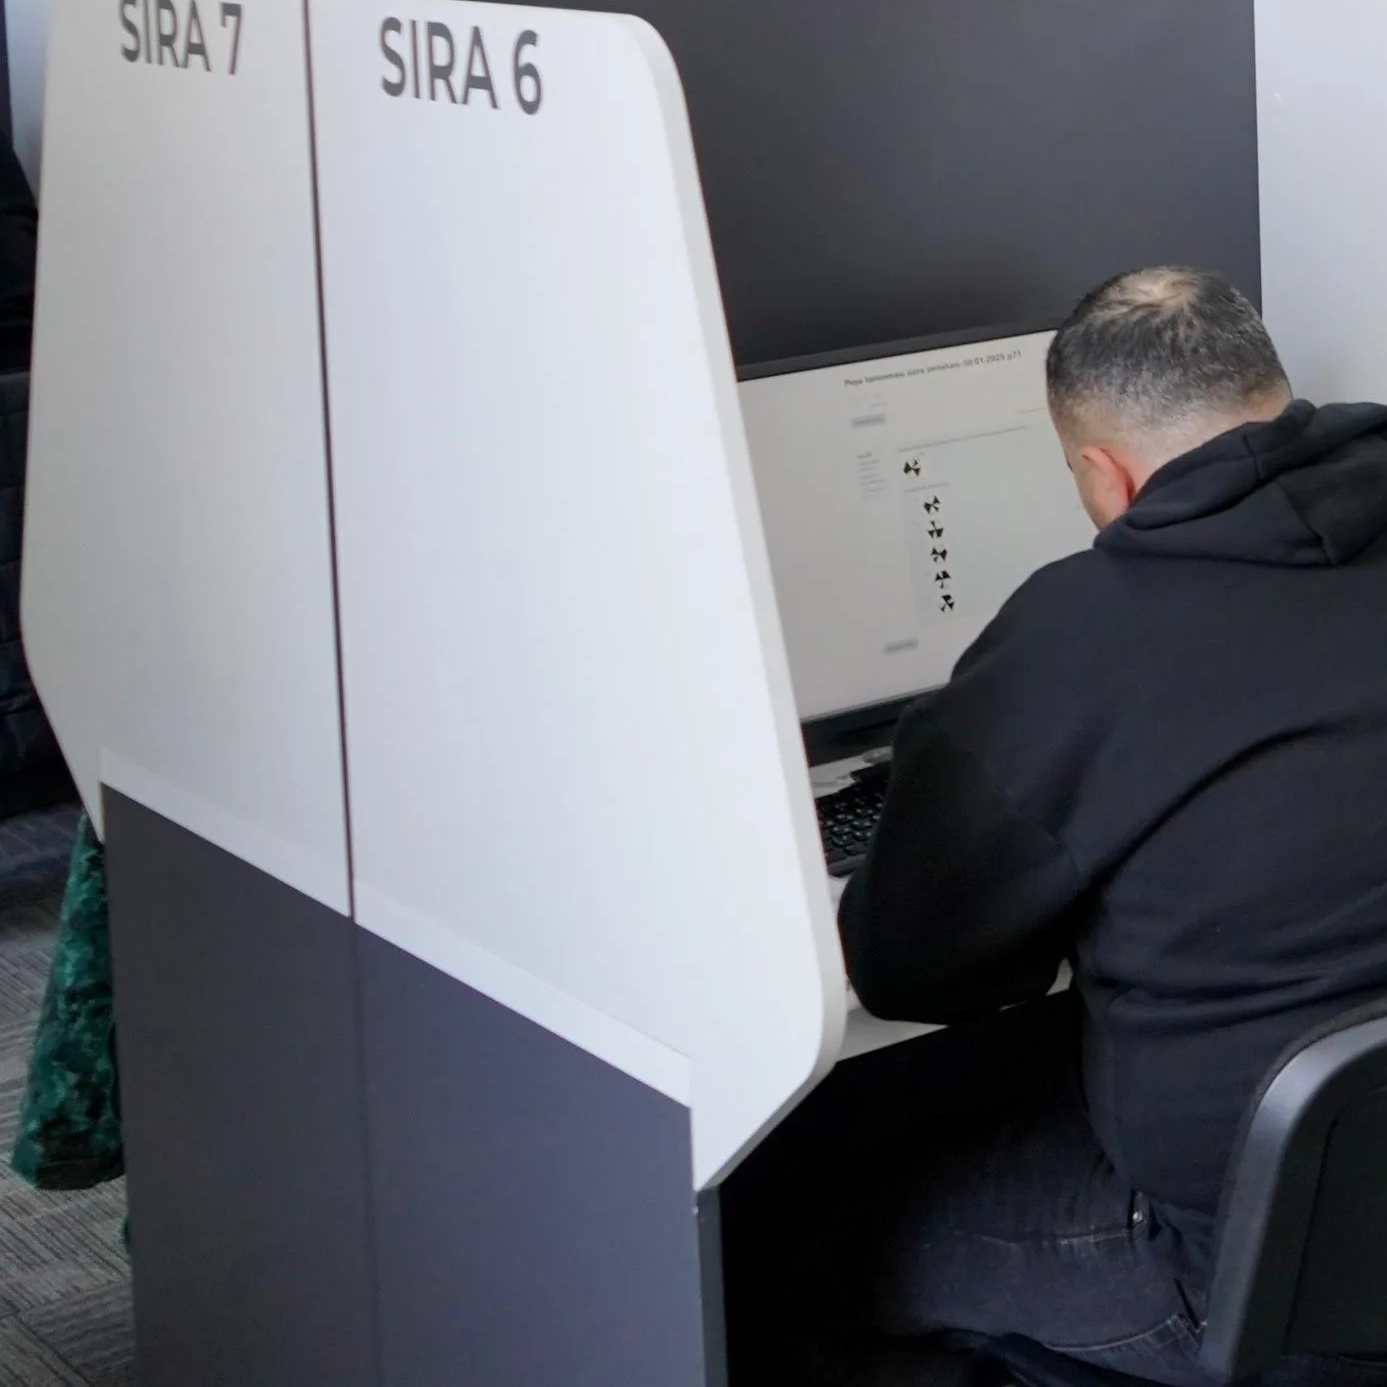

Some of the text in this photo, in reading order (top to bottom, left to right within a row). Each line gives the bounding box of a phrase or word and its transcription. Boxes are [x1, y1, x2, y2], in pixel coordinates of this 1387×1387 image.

[220, 3, 243, 76] 7
[380, 16, 543, 115] SIRA 6
